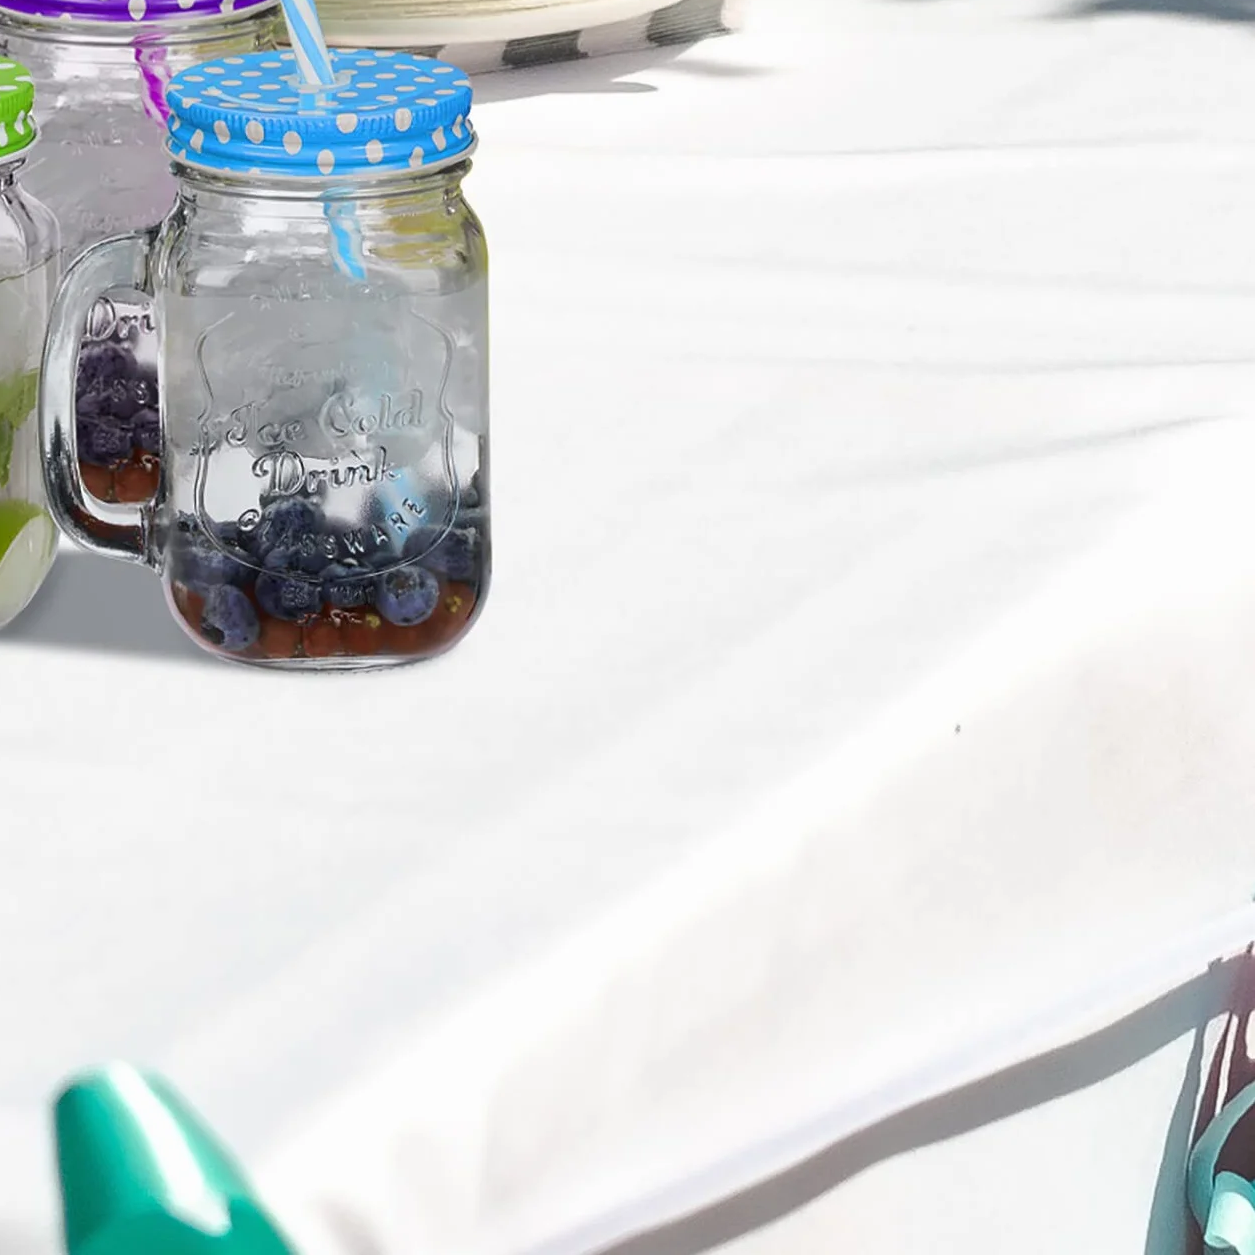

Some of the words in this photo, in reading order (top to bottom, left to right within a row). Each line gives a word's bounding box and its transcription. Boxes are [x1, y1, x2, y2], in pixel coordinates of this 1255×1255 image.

[81, 296, 157, 341] Dri
[226, 401, 306, 447] Ice
[319, 389, 424, 437] Cold
[252, 445, 401, 497] Drink
